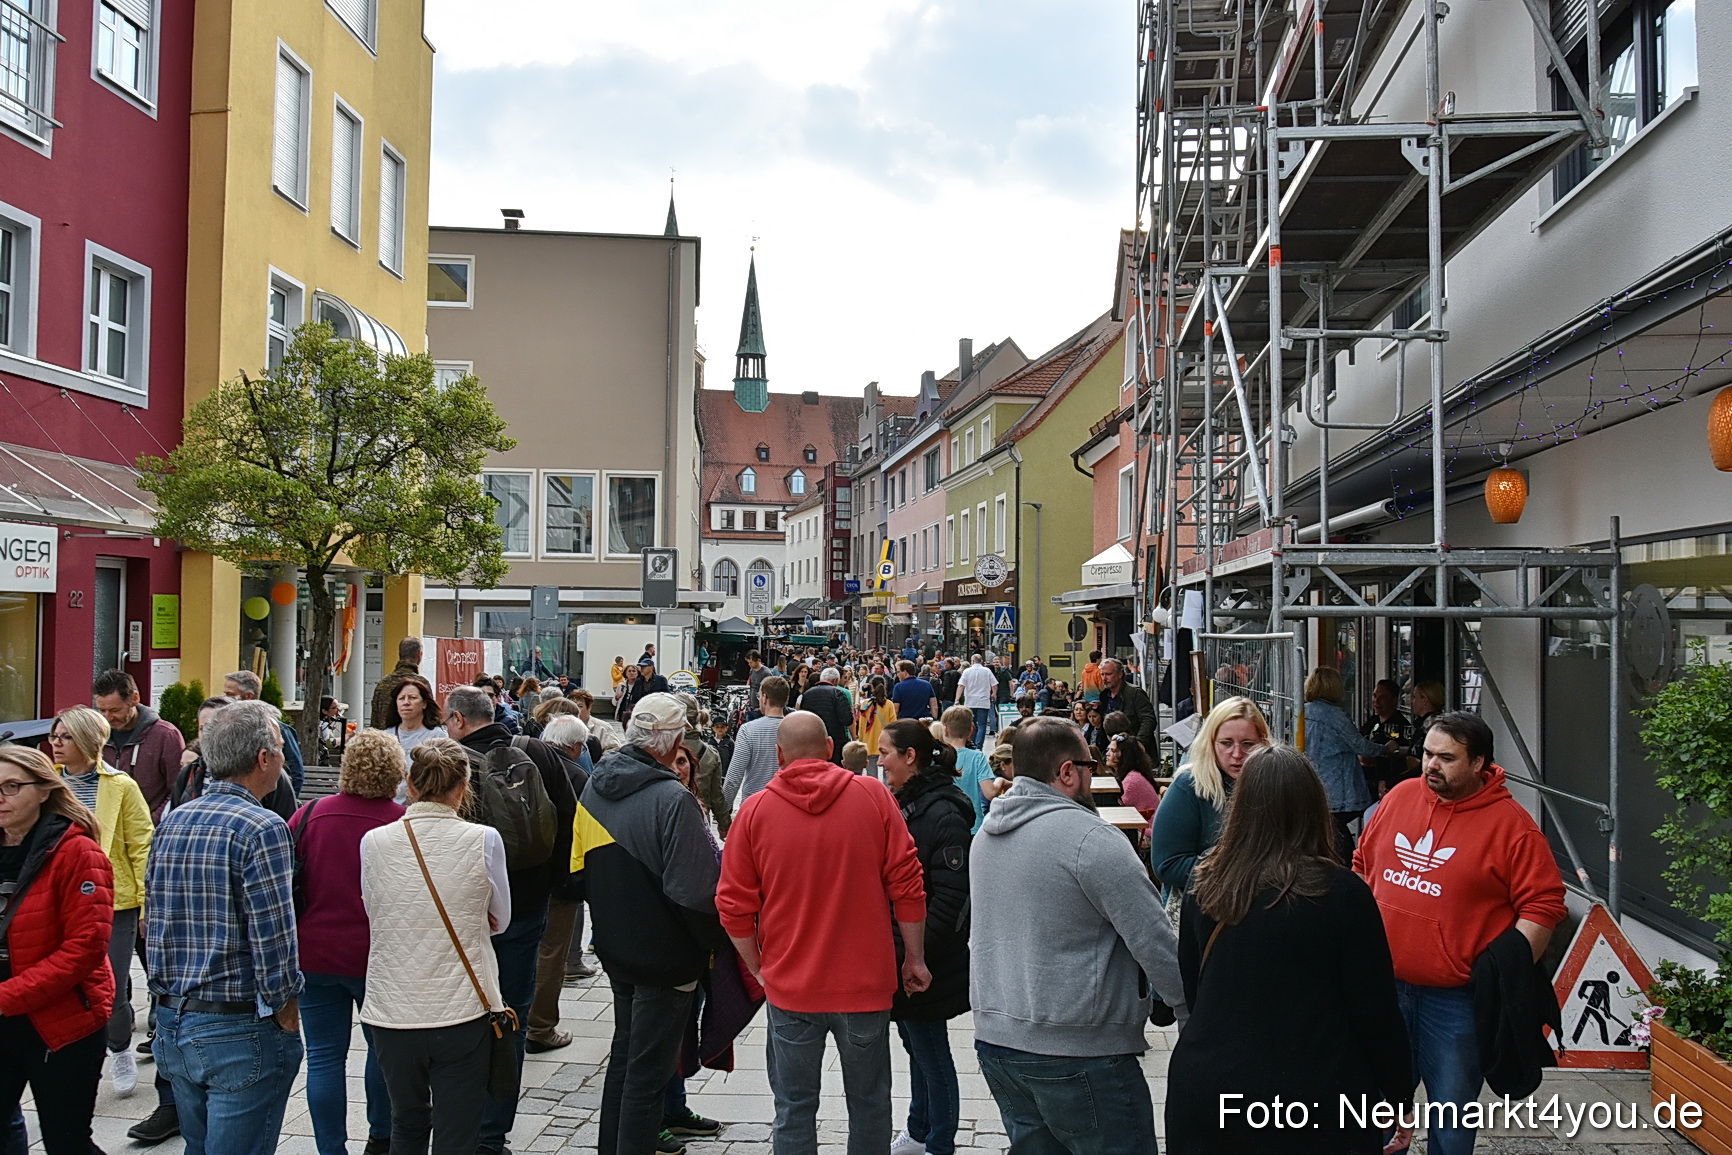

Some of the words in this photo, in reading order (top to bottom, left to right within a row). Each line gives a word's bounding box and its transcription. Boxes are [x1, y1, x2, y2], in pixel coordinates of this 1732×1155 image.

[16, 565, 50, 578] OPTIK
[882, 565, 892, 574] B
[1090, 565, 1122, 578] Creppresso
[69, 590, 84, 608] 22
[1383, 868, 1442, 897] adidas
